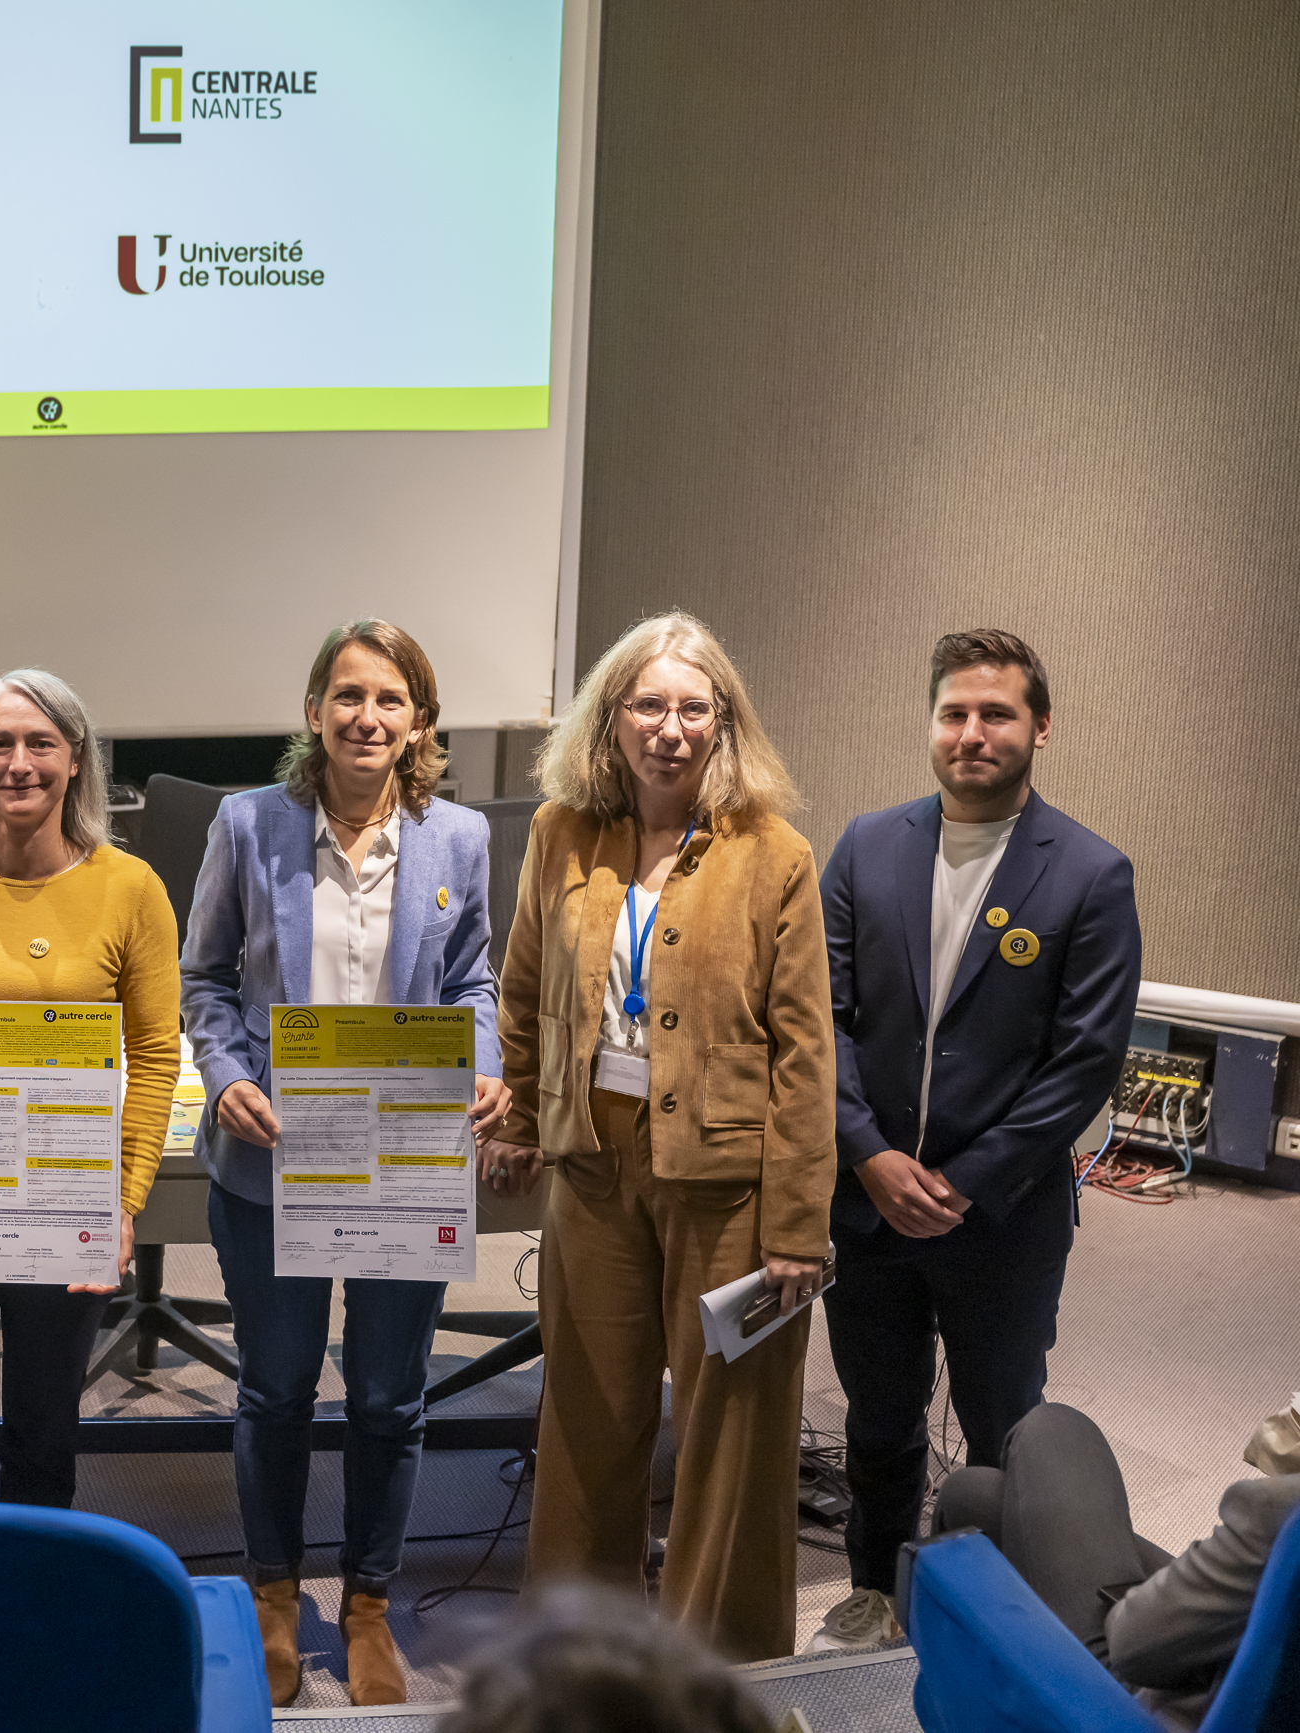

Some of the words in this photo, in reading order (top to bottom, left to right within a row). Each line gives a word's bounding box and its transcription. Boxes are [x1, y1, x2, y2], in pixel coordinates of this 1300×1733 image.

[192, 71, 317, 94] CENTRALE
[192, 98, 282, 119] NANTES
[180, 239, 303, 263] Université
[179, 266, 209, 286] de
[215, 265, 325, 286] Toulouse
[994, 913, 1001, 921] il
[30, 943, 47, 953] elle
[59, 1012, 84, 1020] autre
[85, 1012, 112, 1020] cercle
[410, 1014, 436, 1022] autre
[438, 1014, 465, 1022] cercle
[282, 1032, 315, 1043] Charte
